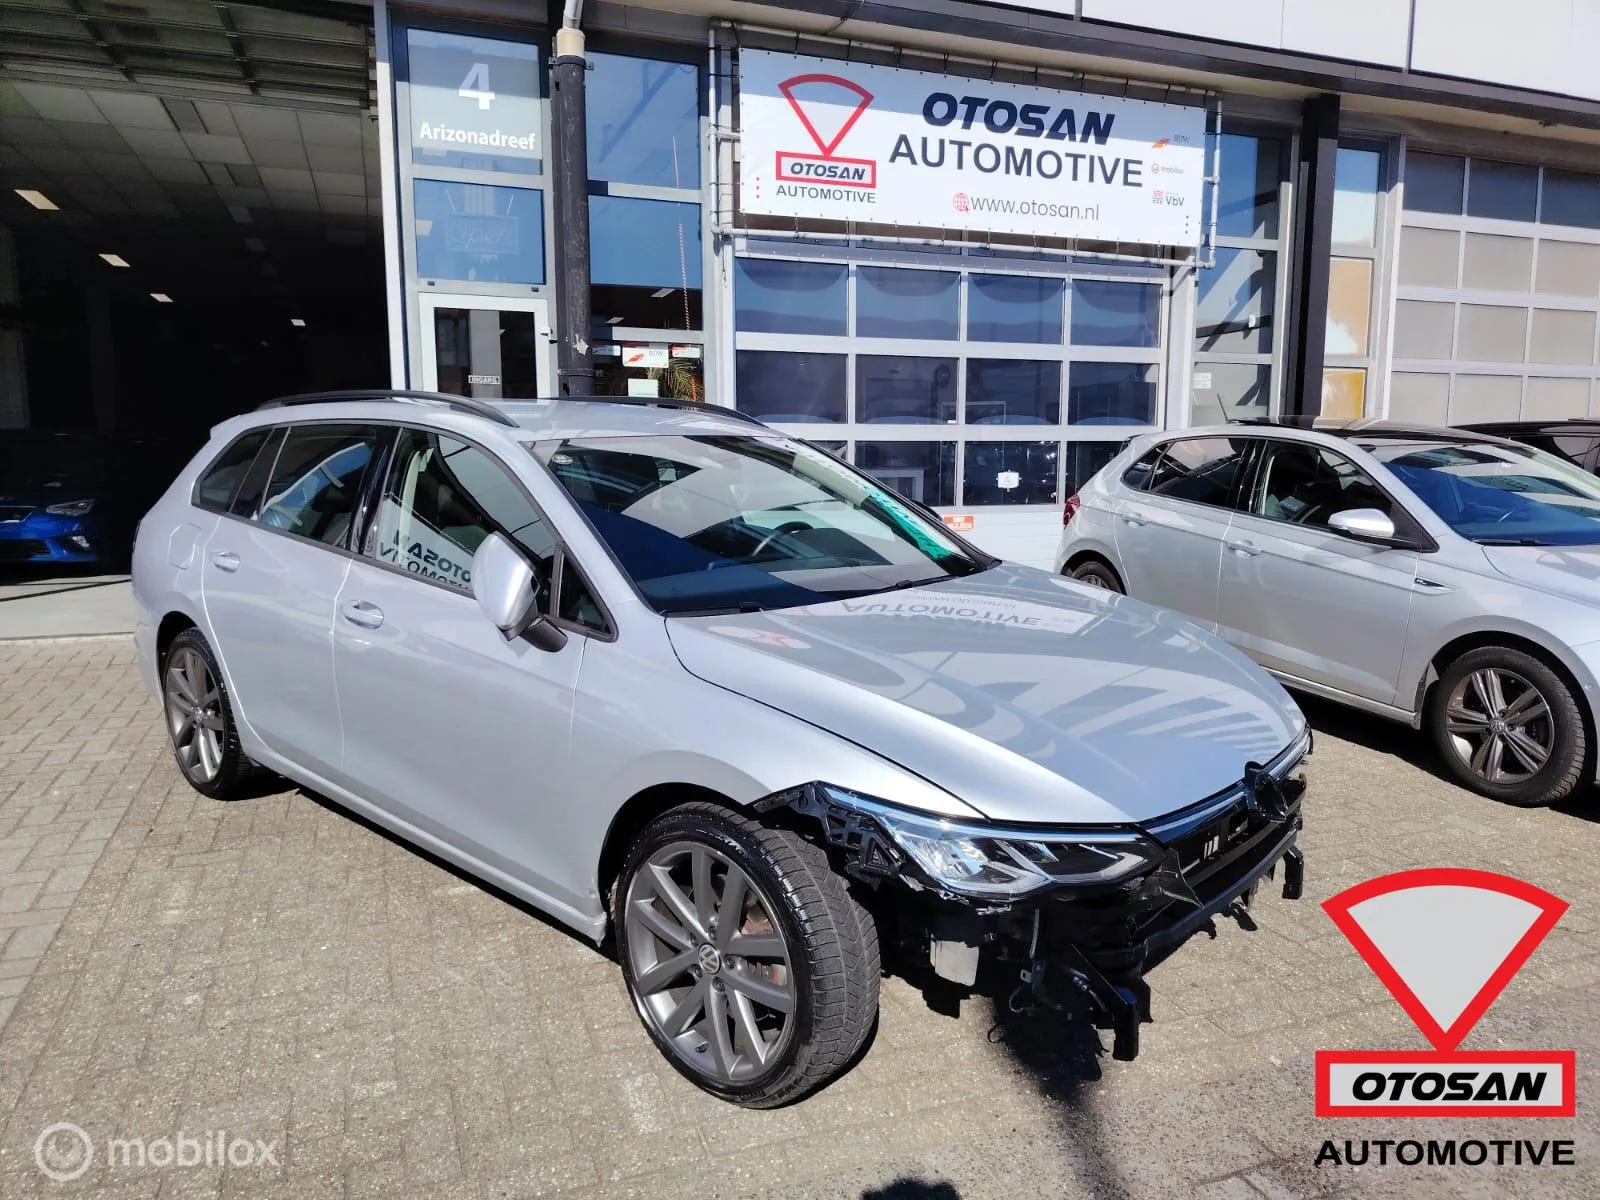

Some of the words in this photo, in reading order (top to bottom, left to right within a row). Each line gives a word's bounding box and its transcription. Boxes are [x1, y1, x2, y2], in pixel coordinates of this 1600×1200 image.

[458, 62, 496, 110] 4
[922, 91, 1116, 146] OTOSAN
[419, 121, 536, 151] Arizonadreef
[790, 162, 866, 181] OTOSAN
[888, 133, 1144, 188] AUTOMOTIVE
[776, 184, 877, 204] AUTOMOTIVE
[970, 196, 1100, 222] www.otosan.nl
